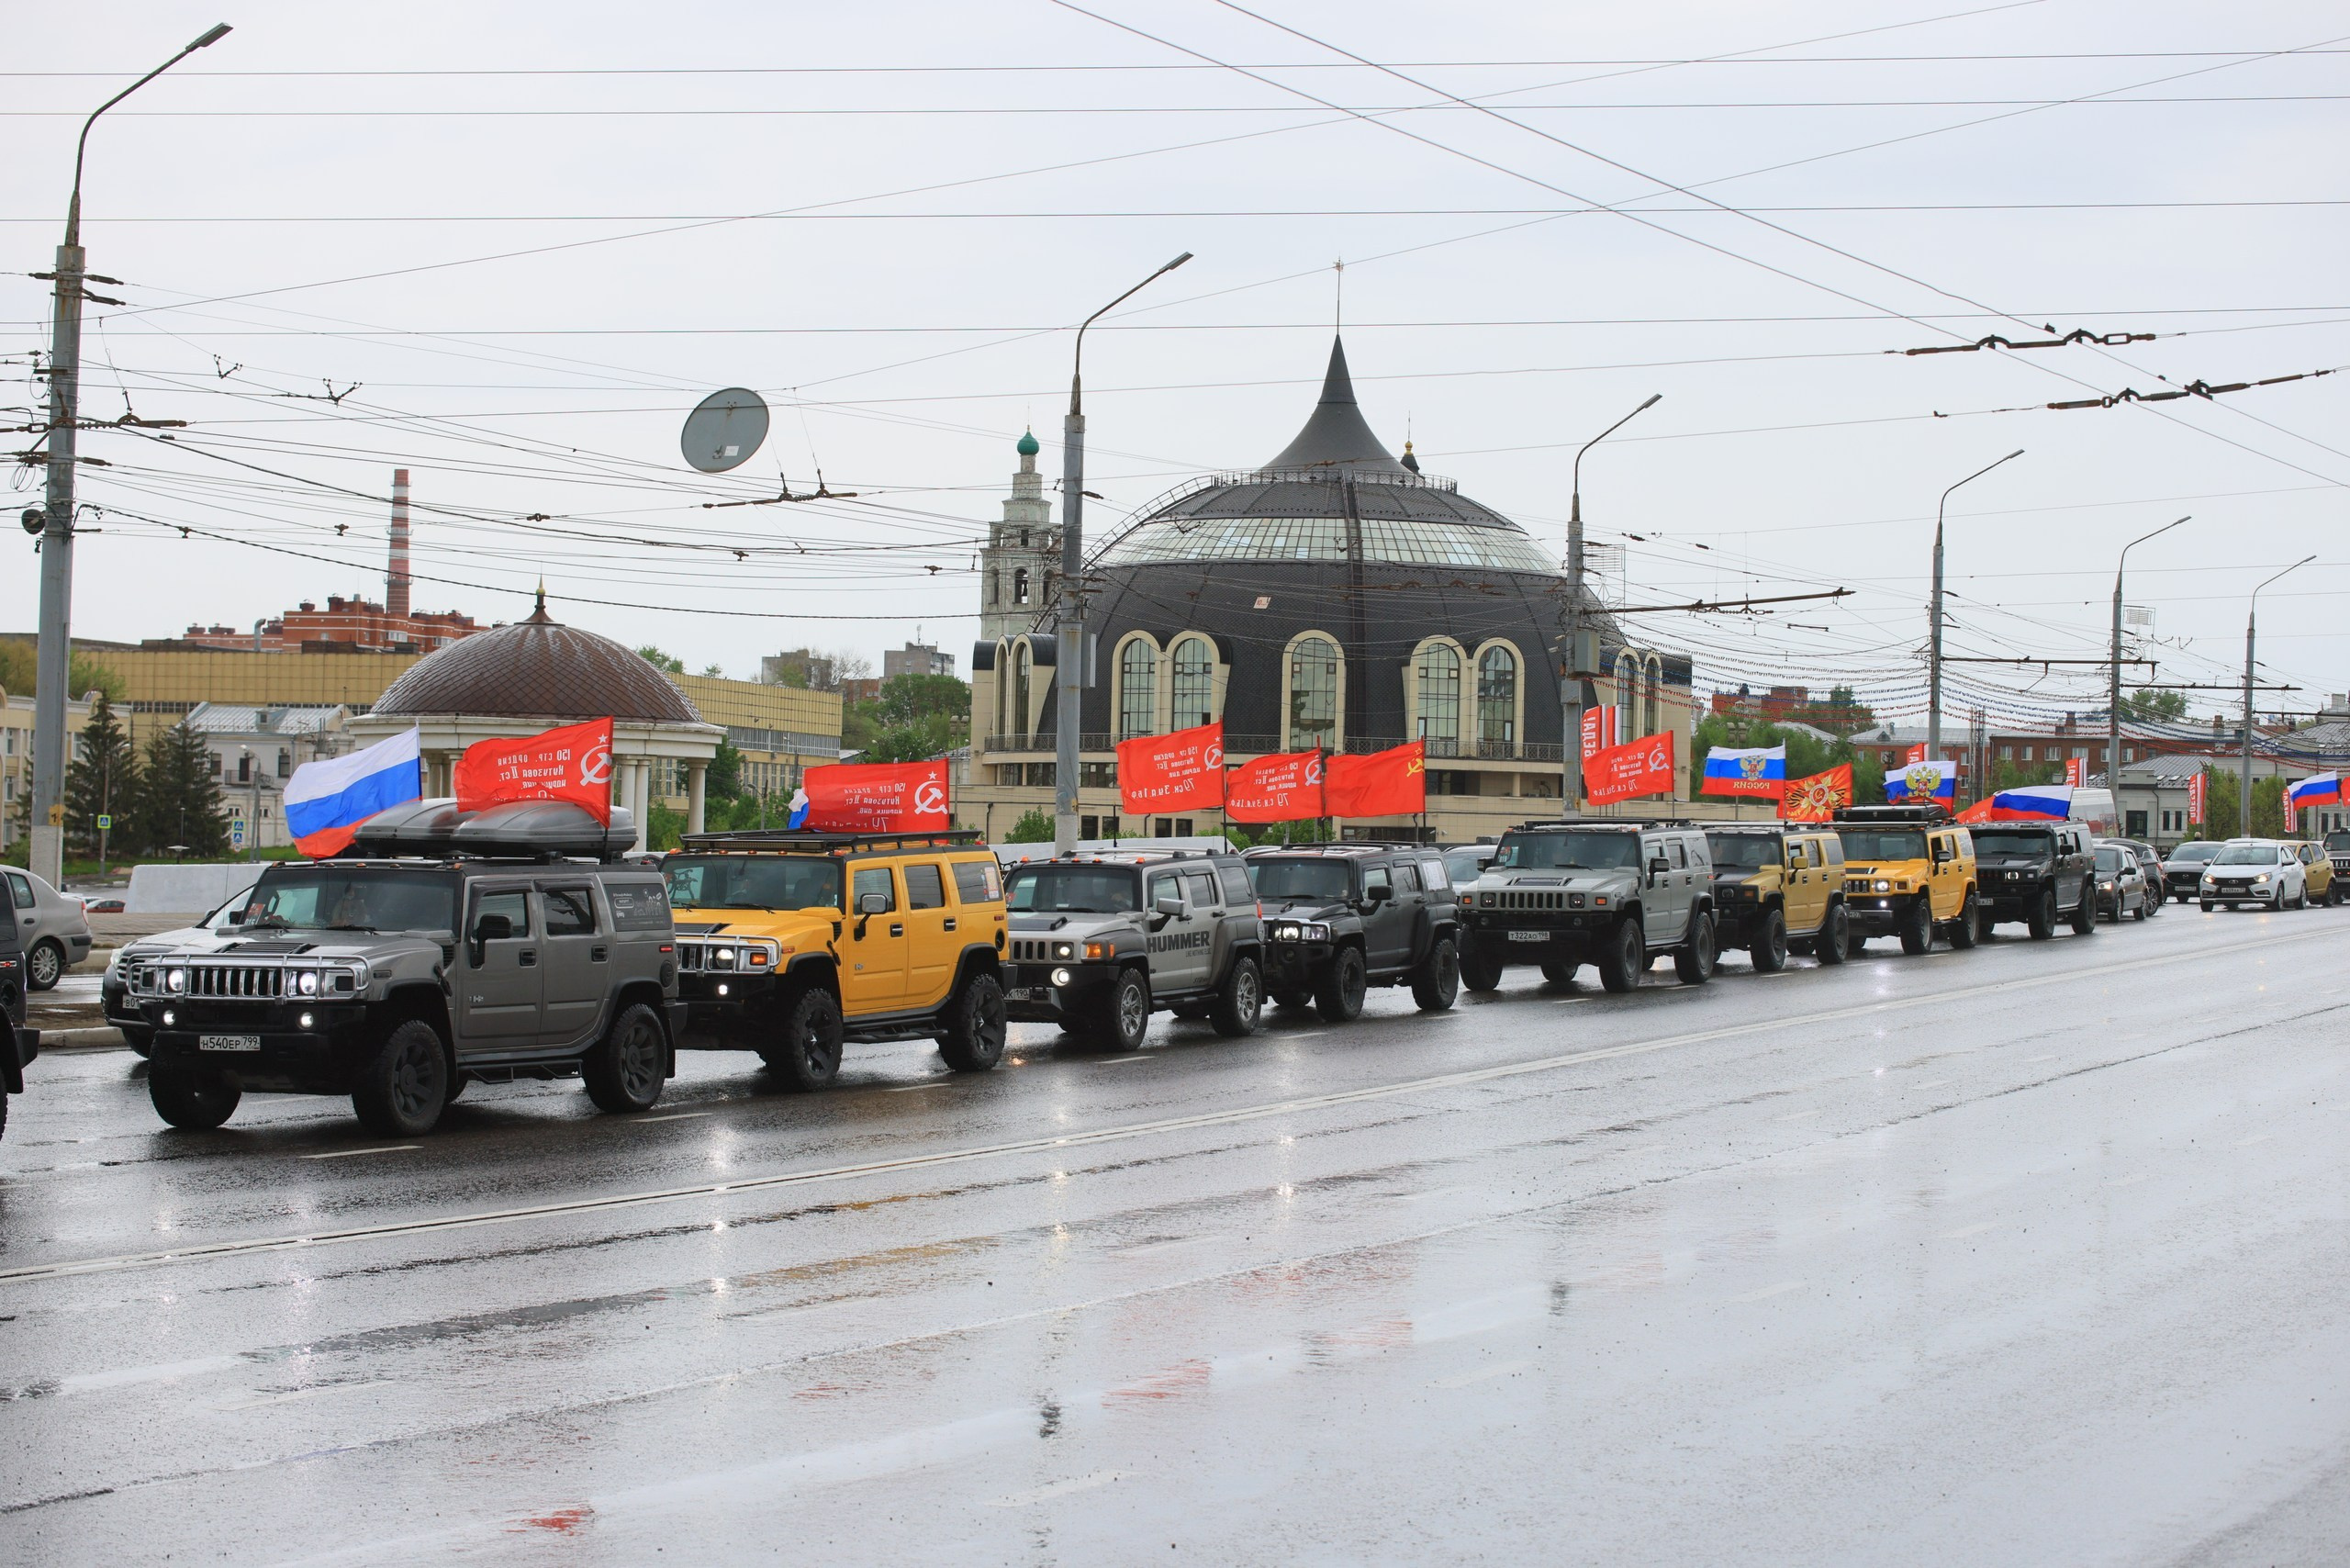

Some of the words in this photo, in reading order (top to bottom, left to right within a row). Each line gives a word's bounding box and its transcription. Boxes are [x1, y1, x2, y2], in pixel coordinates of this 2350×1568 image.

[1583, 716, 1595, 757] БЕДА!
[1147, 931, 1210, 953] HUMMER
[202, 1037, 241, 1049] Н540ЕР
[242, 1036, 258, 1046] 799
